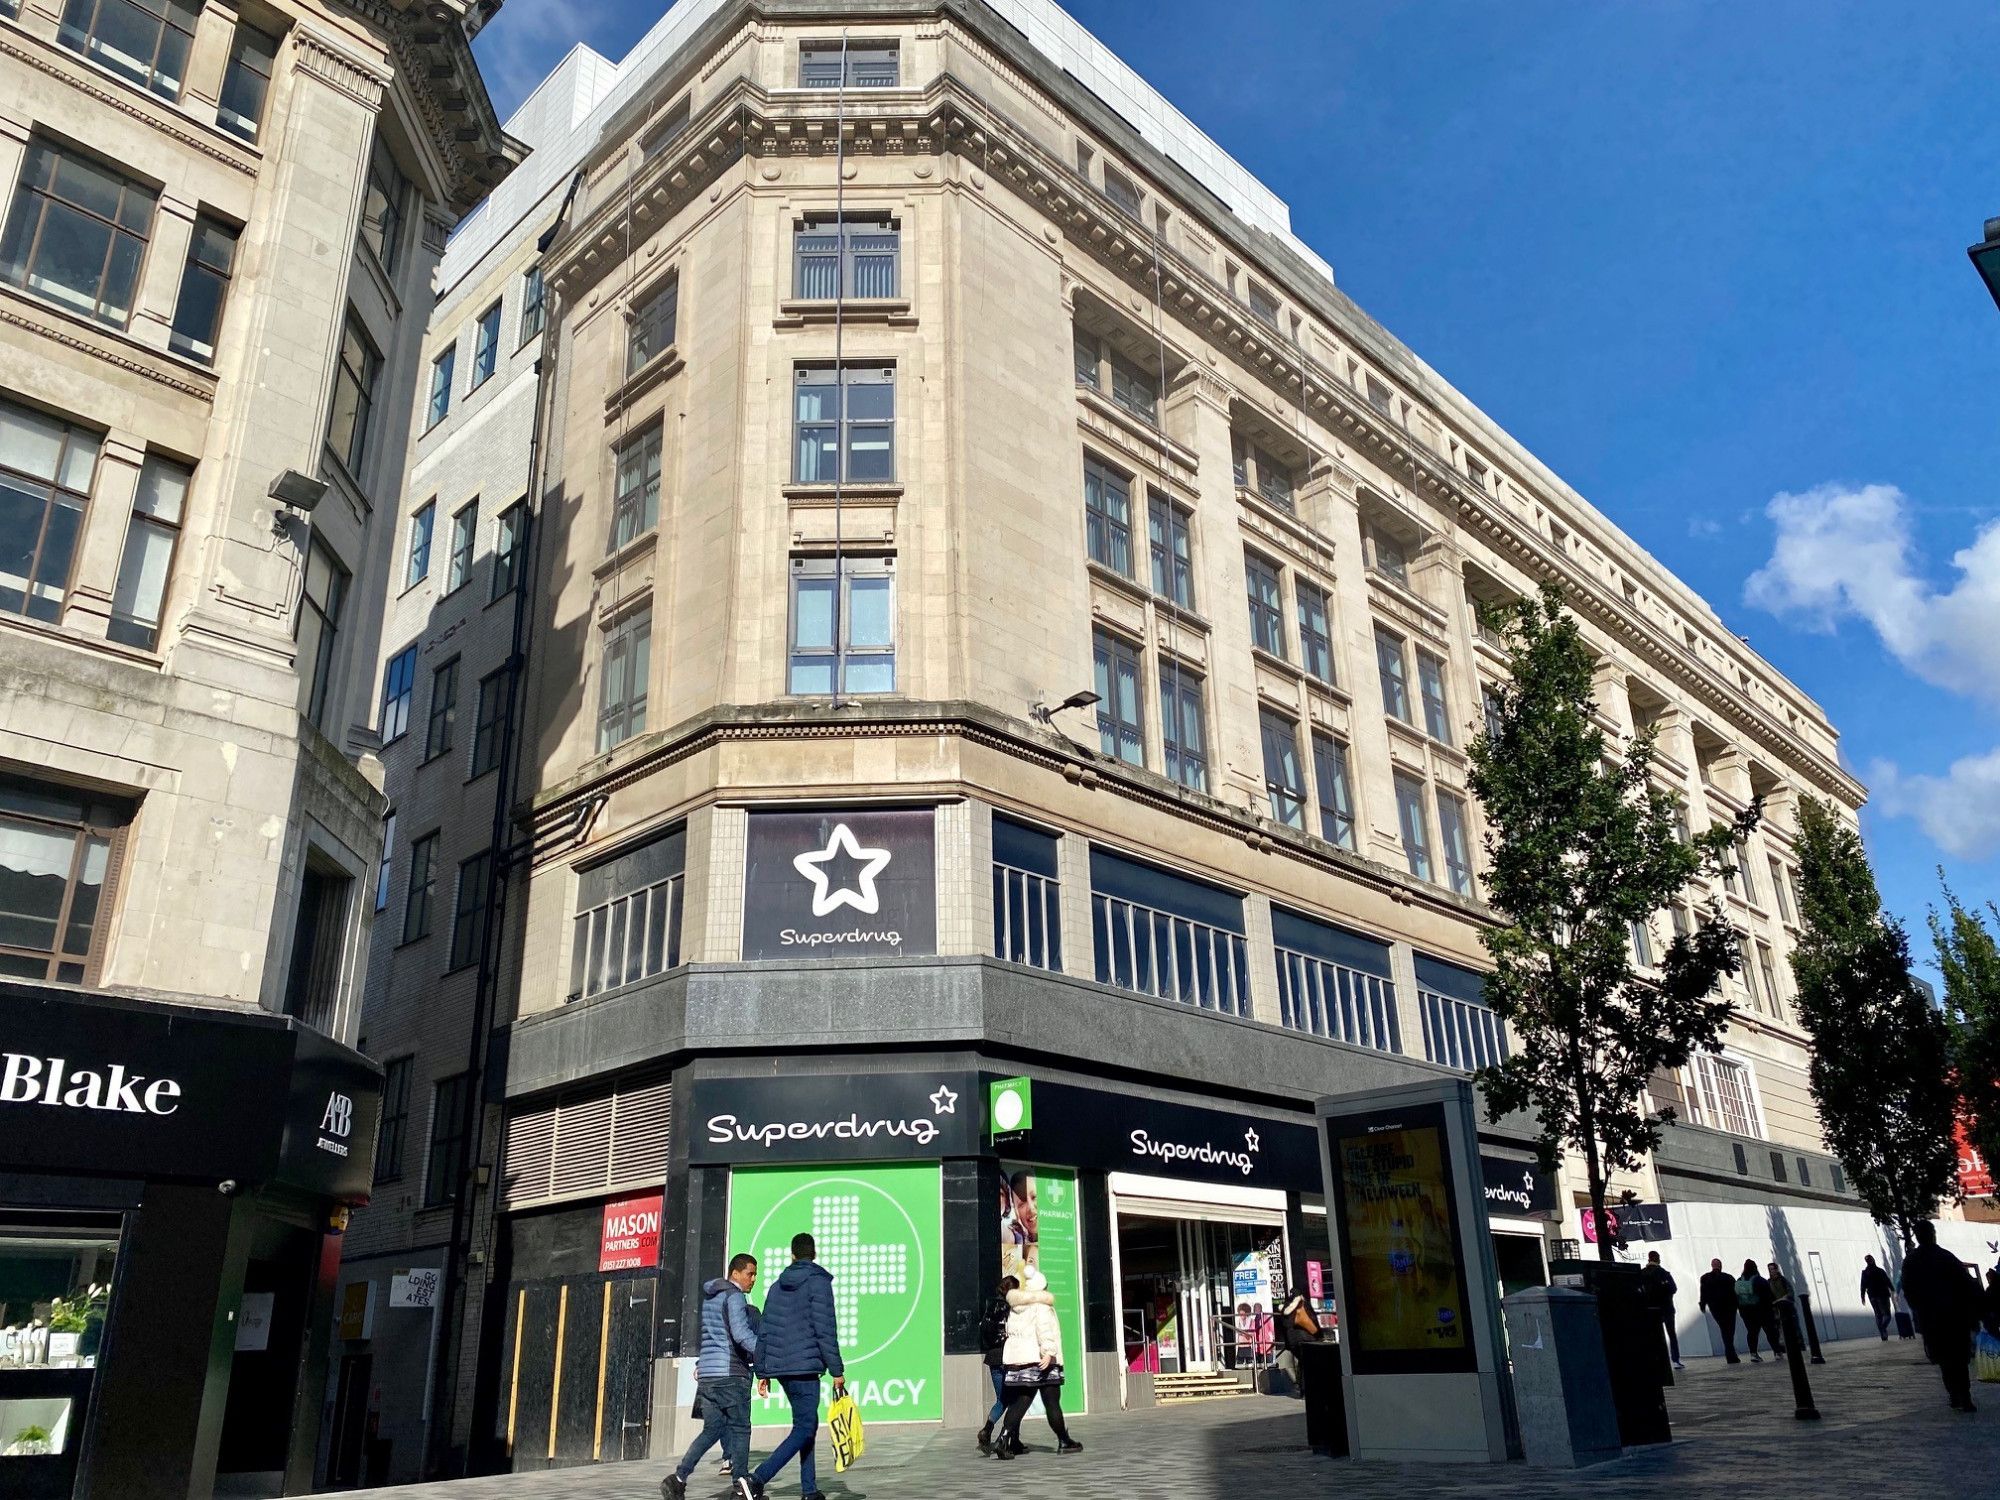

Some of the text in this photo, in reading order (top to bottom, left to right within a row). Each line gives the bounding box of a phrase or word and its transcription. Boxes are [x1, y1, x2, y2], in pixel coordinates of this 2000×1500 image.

[779, 928, 902, 947] Superdrug
[0, 1053, 182, 1115] Blake
[318, 1090, 353, 1137] A&B
[707, 1113, 939, 1148] Superdrug
[1130, 1129, 1254, 1175] Superdrug
[1039, 1209, 1073, 1219] PHARMACY
[606, 1211, 658, 1238] MASON
[603, 1259, 615, 1270] 0151
[408, 1275, 436, 1290] LDING
[416, 1286, 435, 1298] EST
[405, 1293, 430, 1306] ATES
